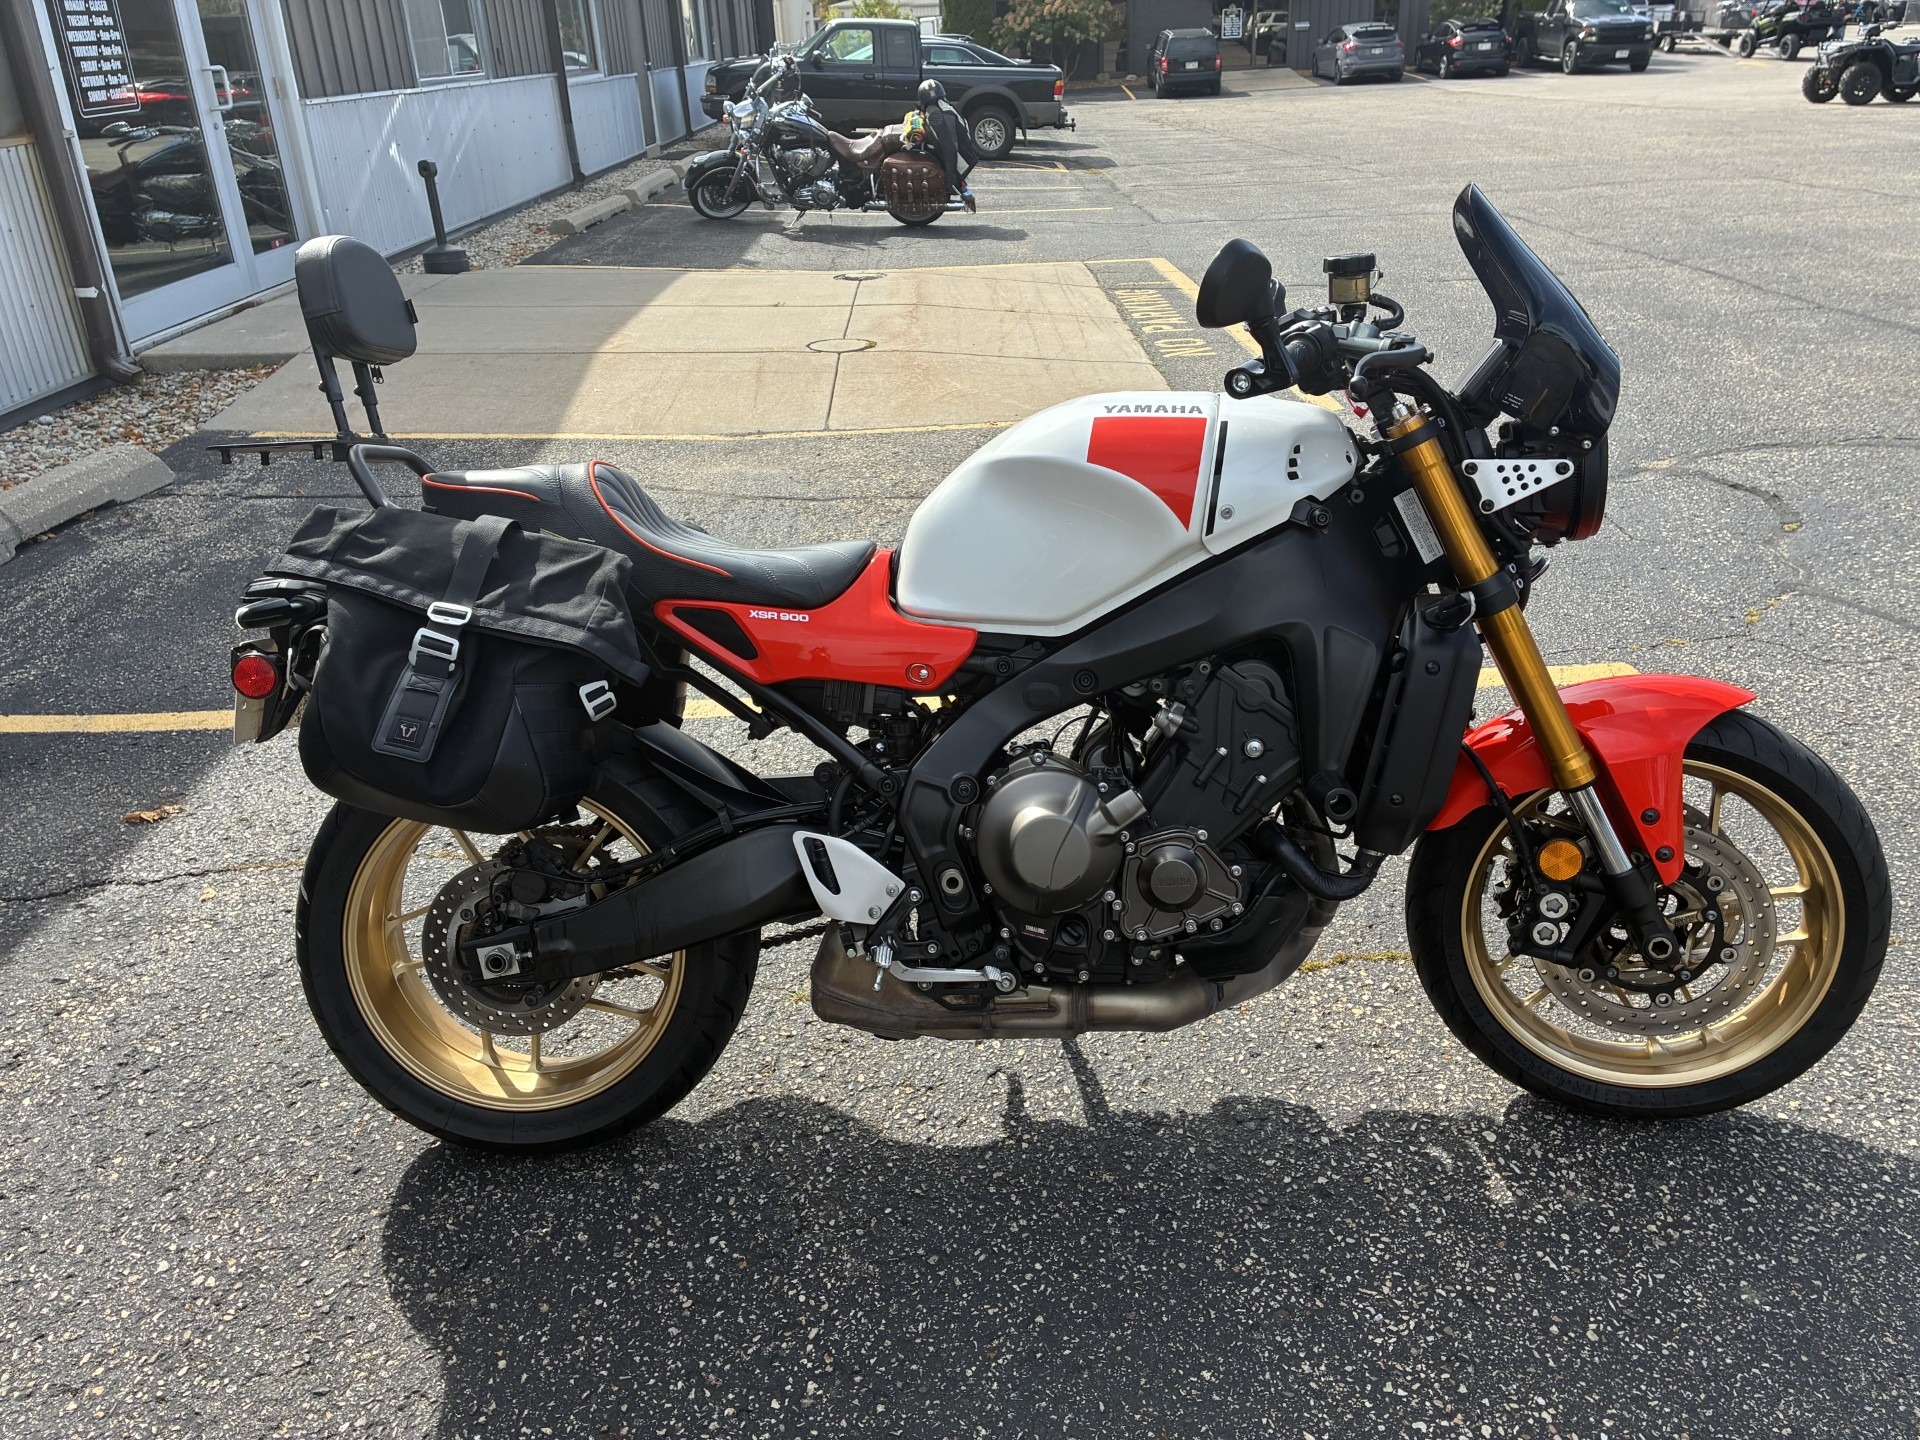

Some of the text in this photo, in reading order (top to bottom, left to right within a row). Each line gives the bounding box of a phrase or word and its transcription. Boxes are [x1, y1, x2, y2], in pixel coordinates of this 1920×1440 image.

[1114, 289, 1217, 358] NO PARKING
[1103, 404, 1204, 414] YAMAHA
[749, 610, 810, 622] XSR 900
